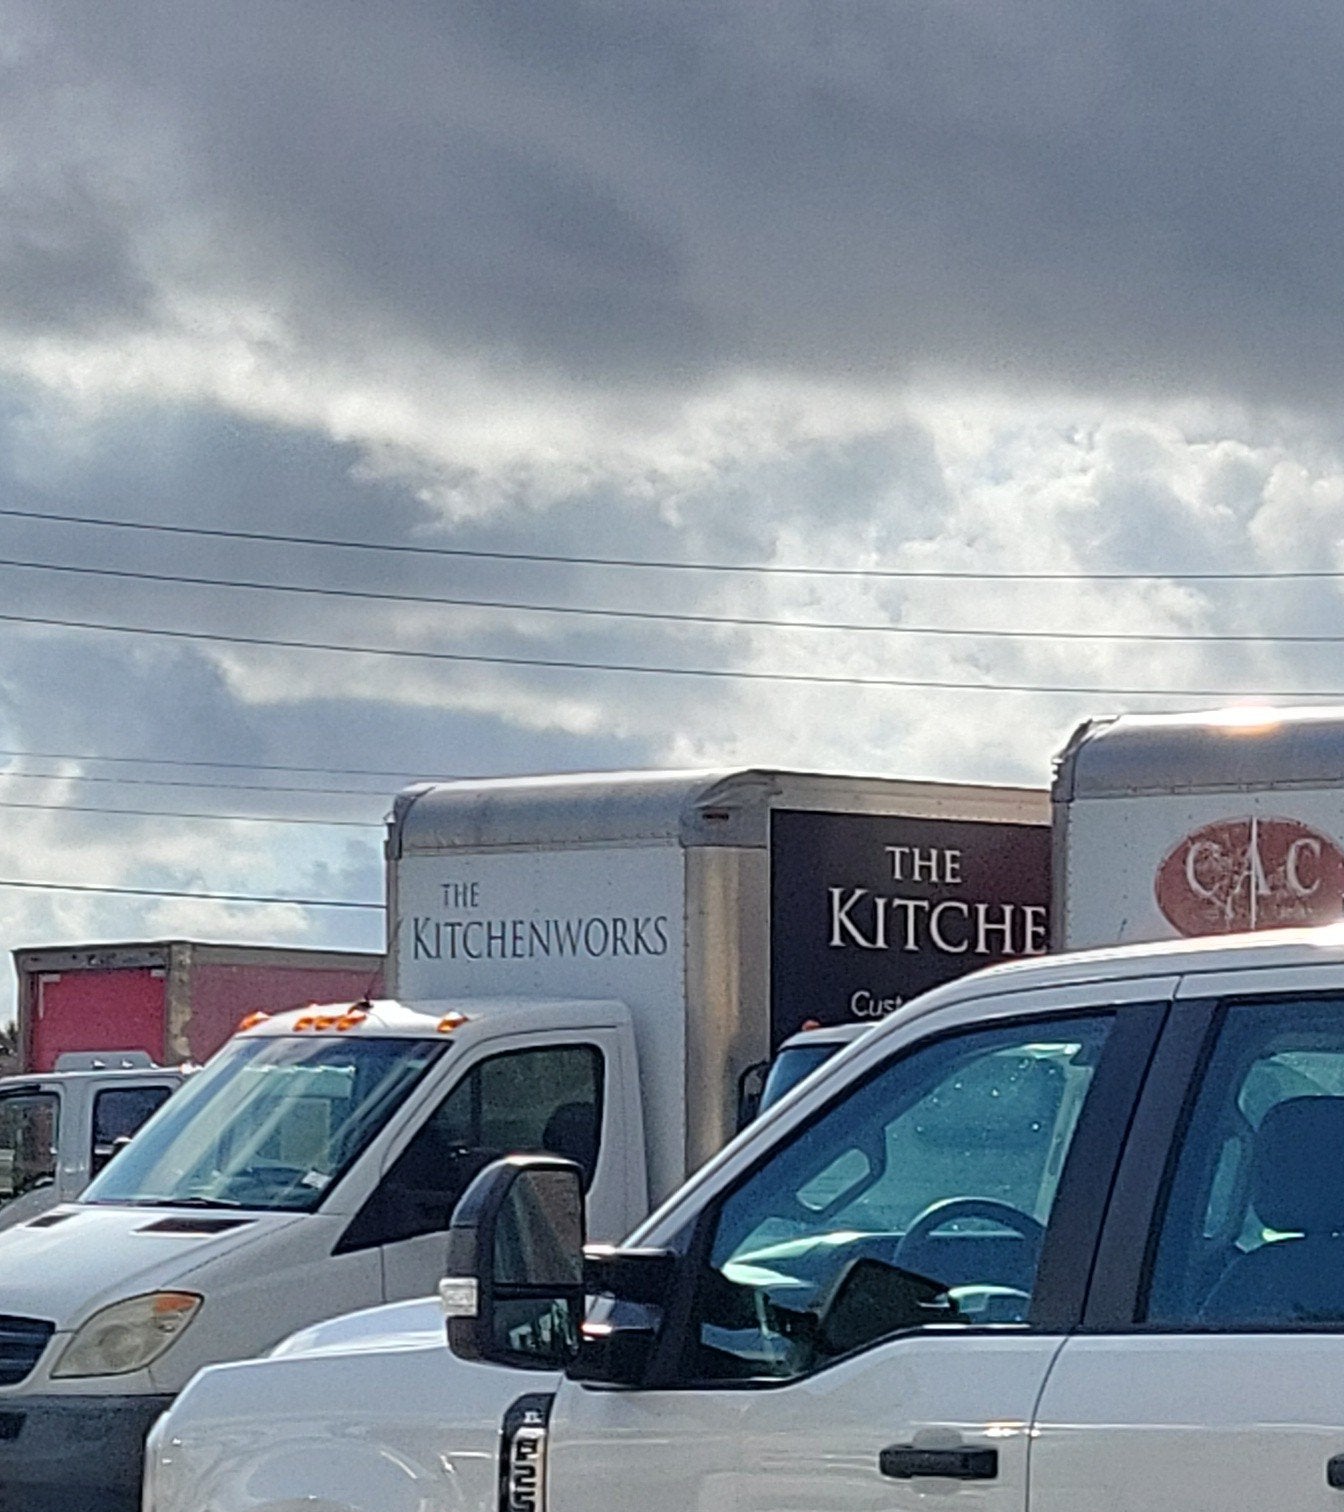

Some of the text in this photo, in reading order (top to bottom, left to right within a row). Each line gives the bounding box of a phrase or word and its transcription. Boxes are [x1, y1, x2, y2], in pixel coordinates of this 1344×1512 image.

[884, 846, 963, 884] THE
[441, 882, 480, 908] THE
[413, 915, 668, 960] KITCHENWORKS
